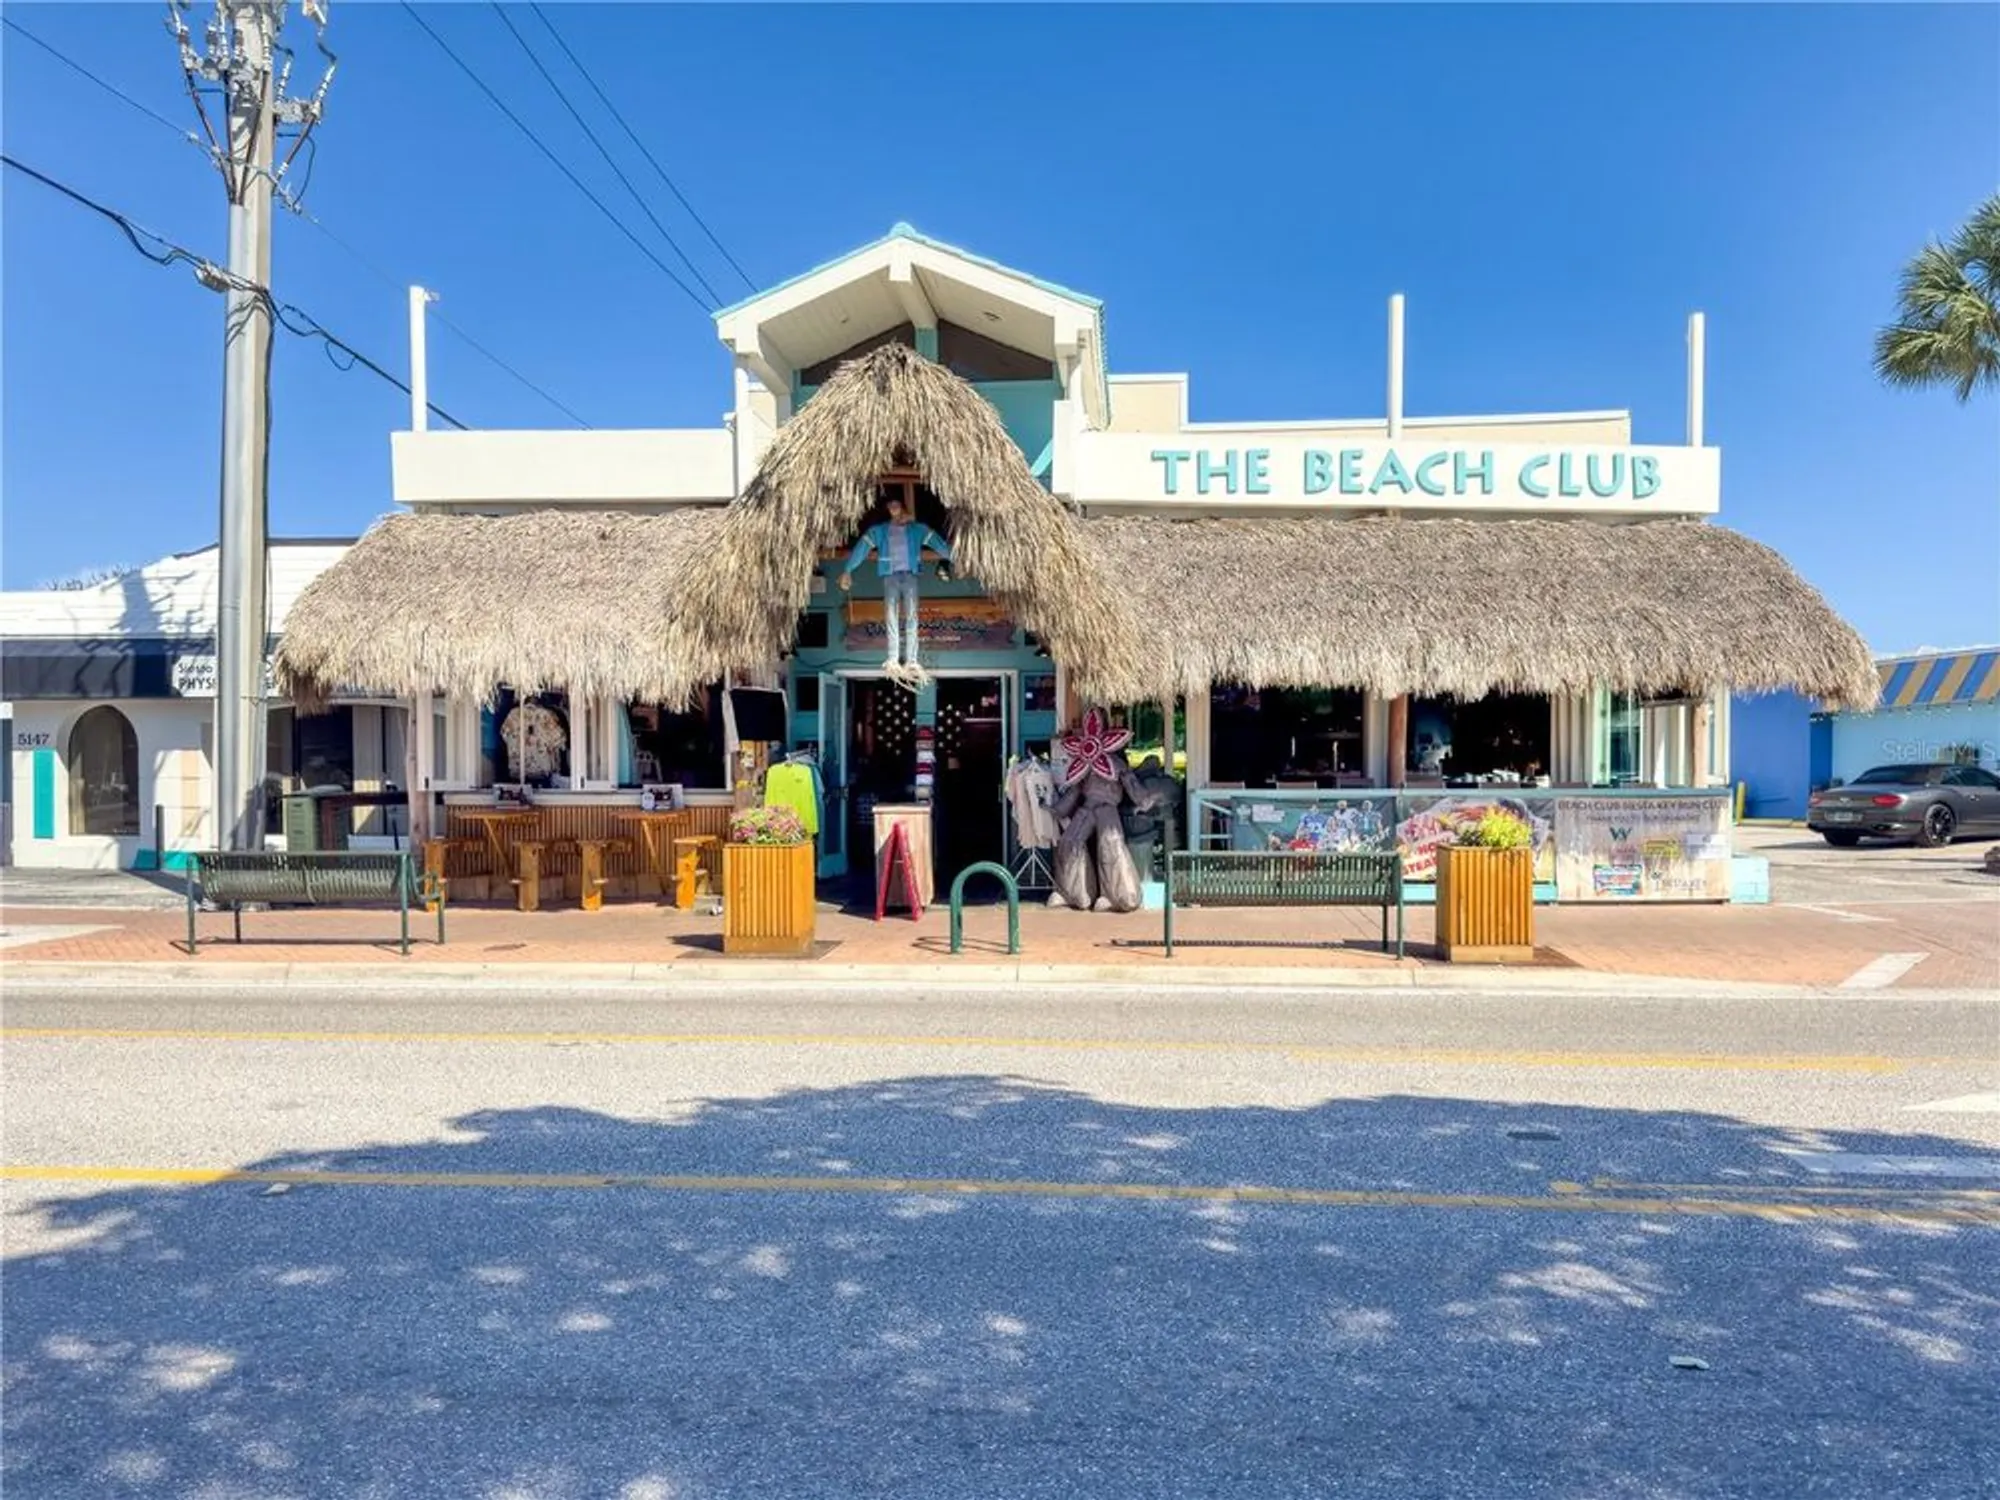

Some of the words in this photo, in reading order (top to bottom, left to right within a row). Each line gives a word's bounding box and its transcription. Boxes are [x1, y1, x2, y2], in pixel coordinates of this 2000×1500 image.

[1151, 449, 1270, 494] THE
[1304, 449, 1493, 496] BEACH
[1518, 452, 1662, 499] CLUB
[18, 733, 50, 745] 5147
[1594, 801, 1621, 811] CLUB
